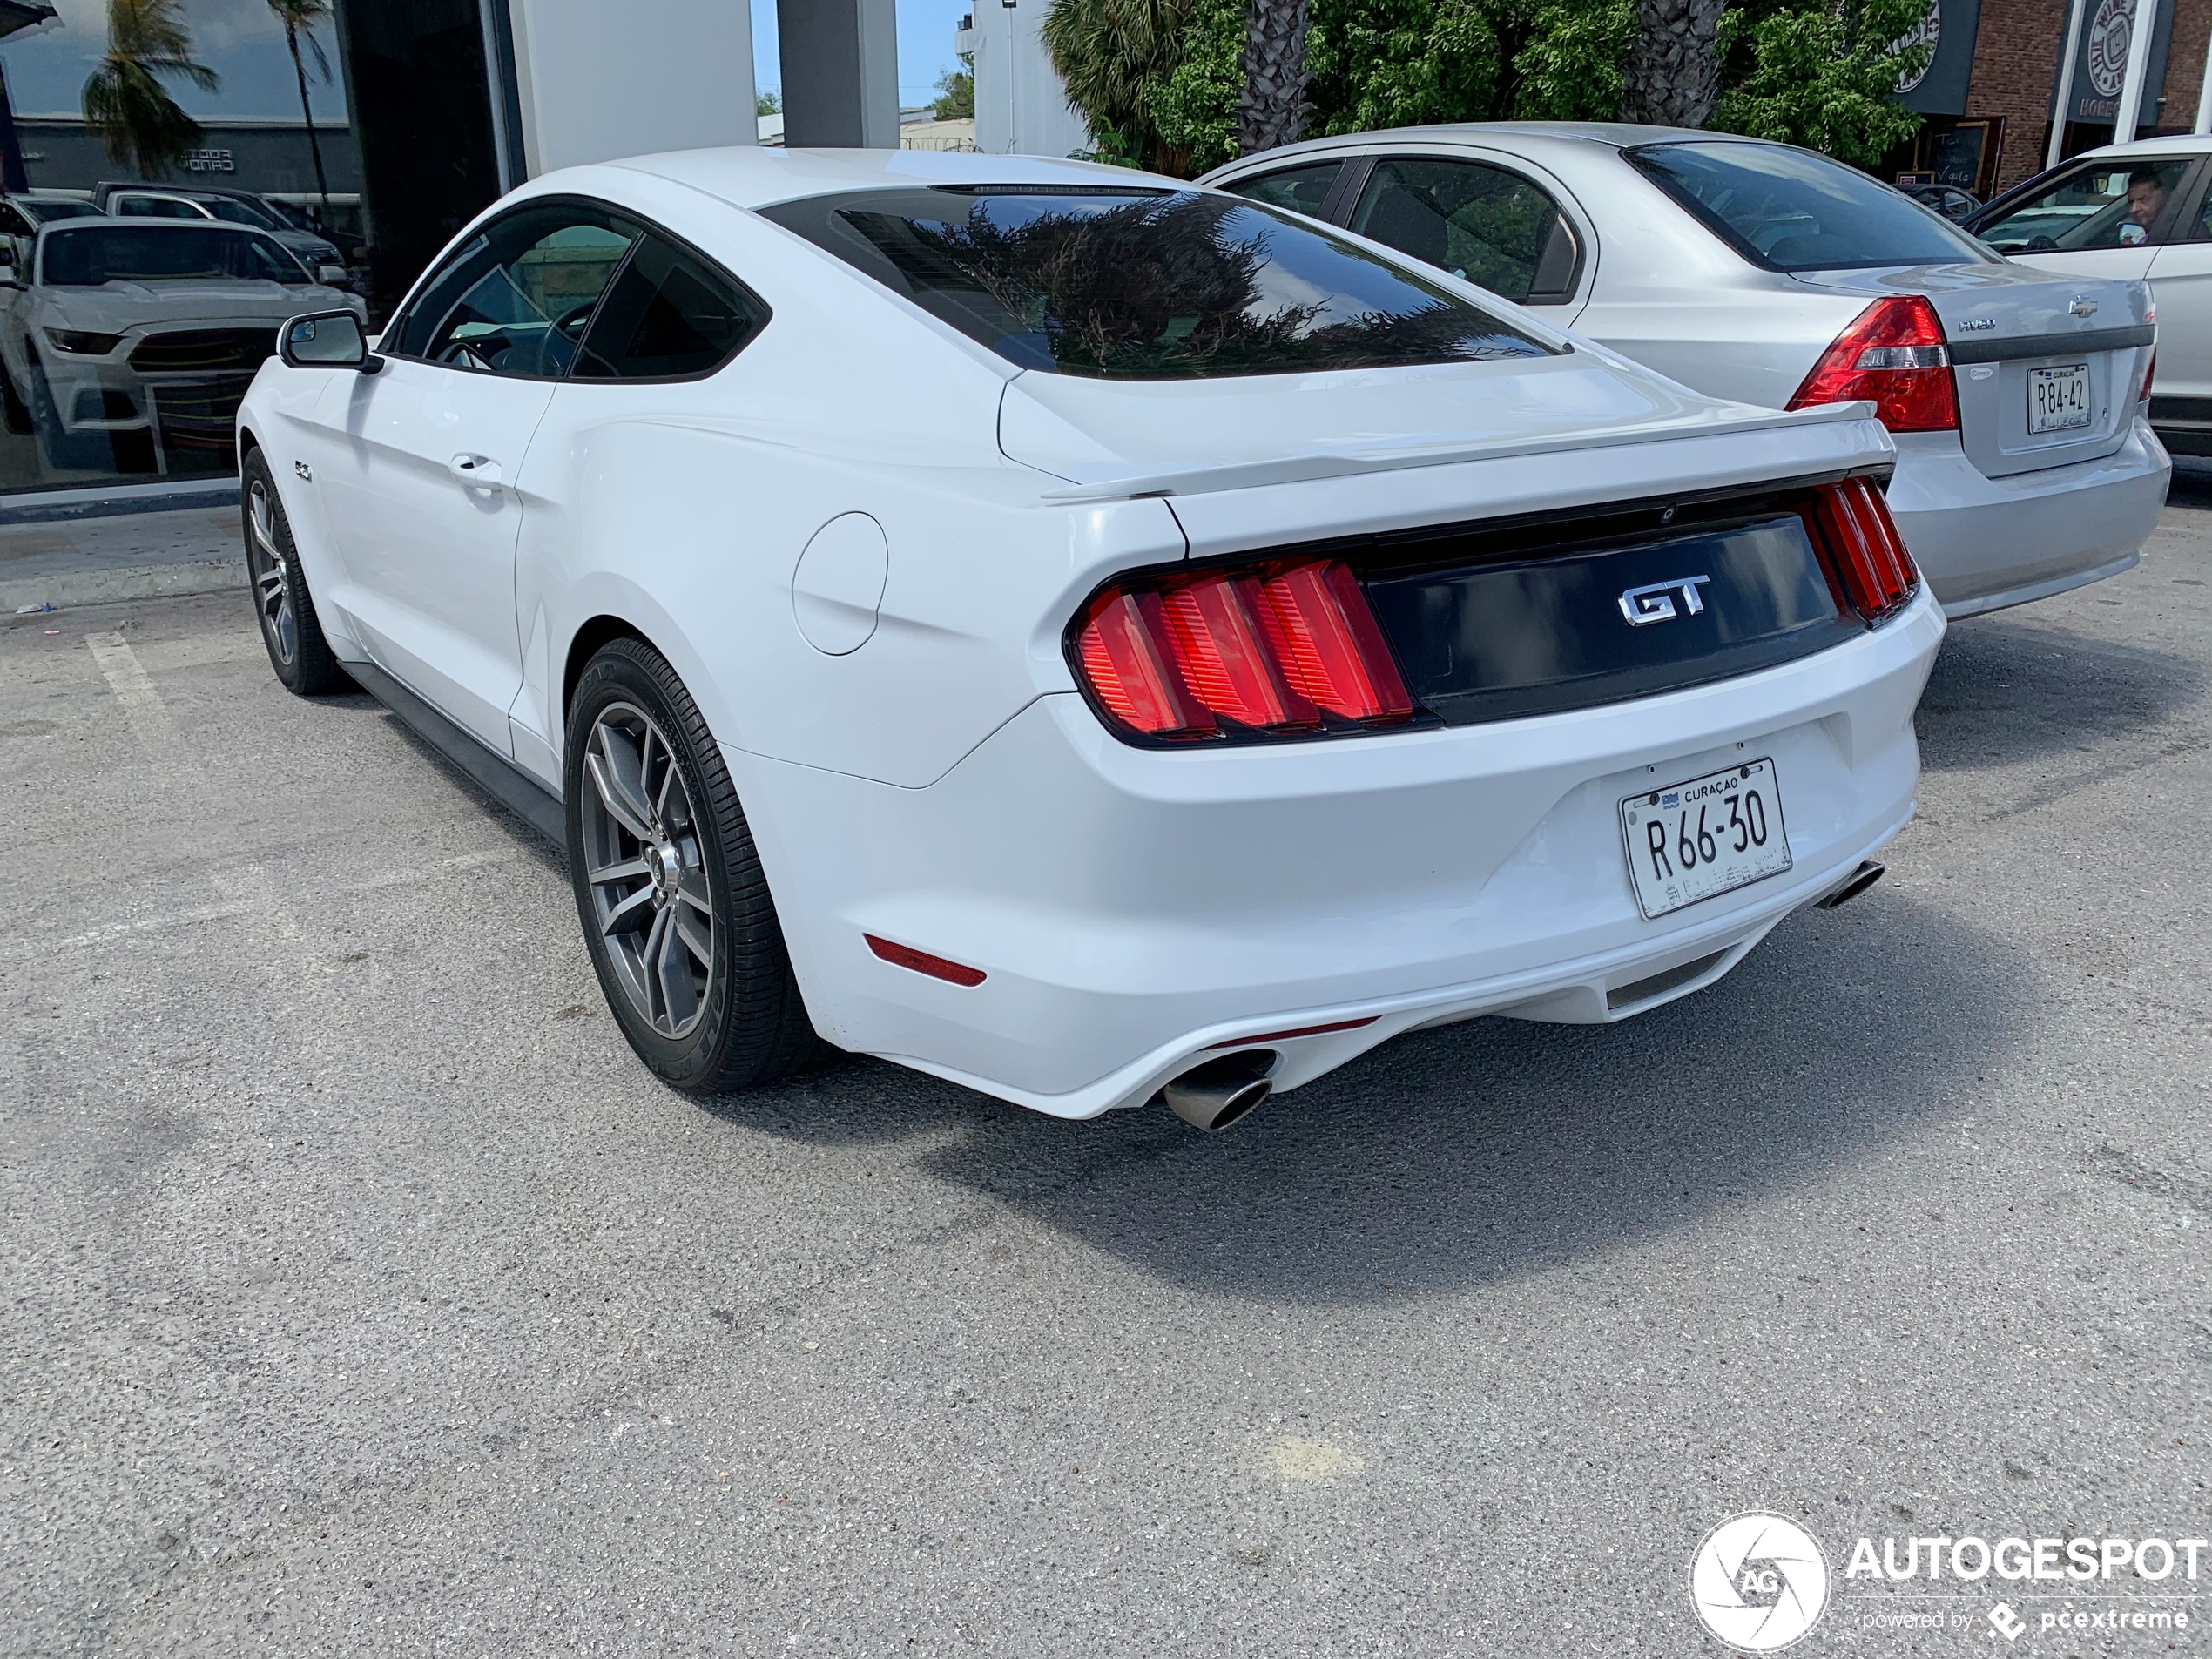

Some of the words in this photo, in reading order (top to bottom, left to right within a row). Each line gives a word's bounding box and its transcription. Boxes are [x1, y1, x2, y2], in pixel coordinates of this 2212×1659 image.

[2038, 379, 2083, 415] R84-42
[1618, 575, 1710, 627] GT
[1684, 777, 1738, 803] CURAÇAO
